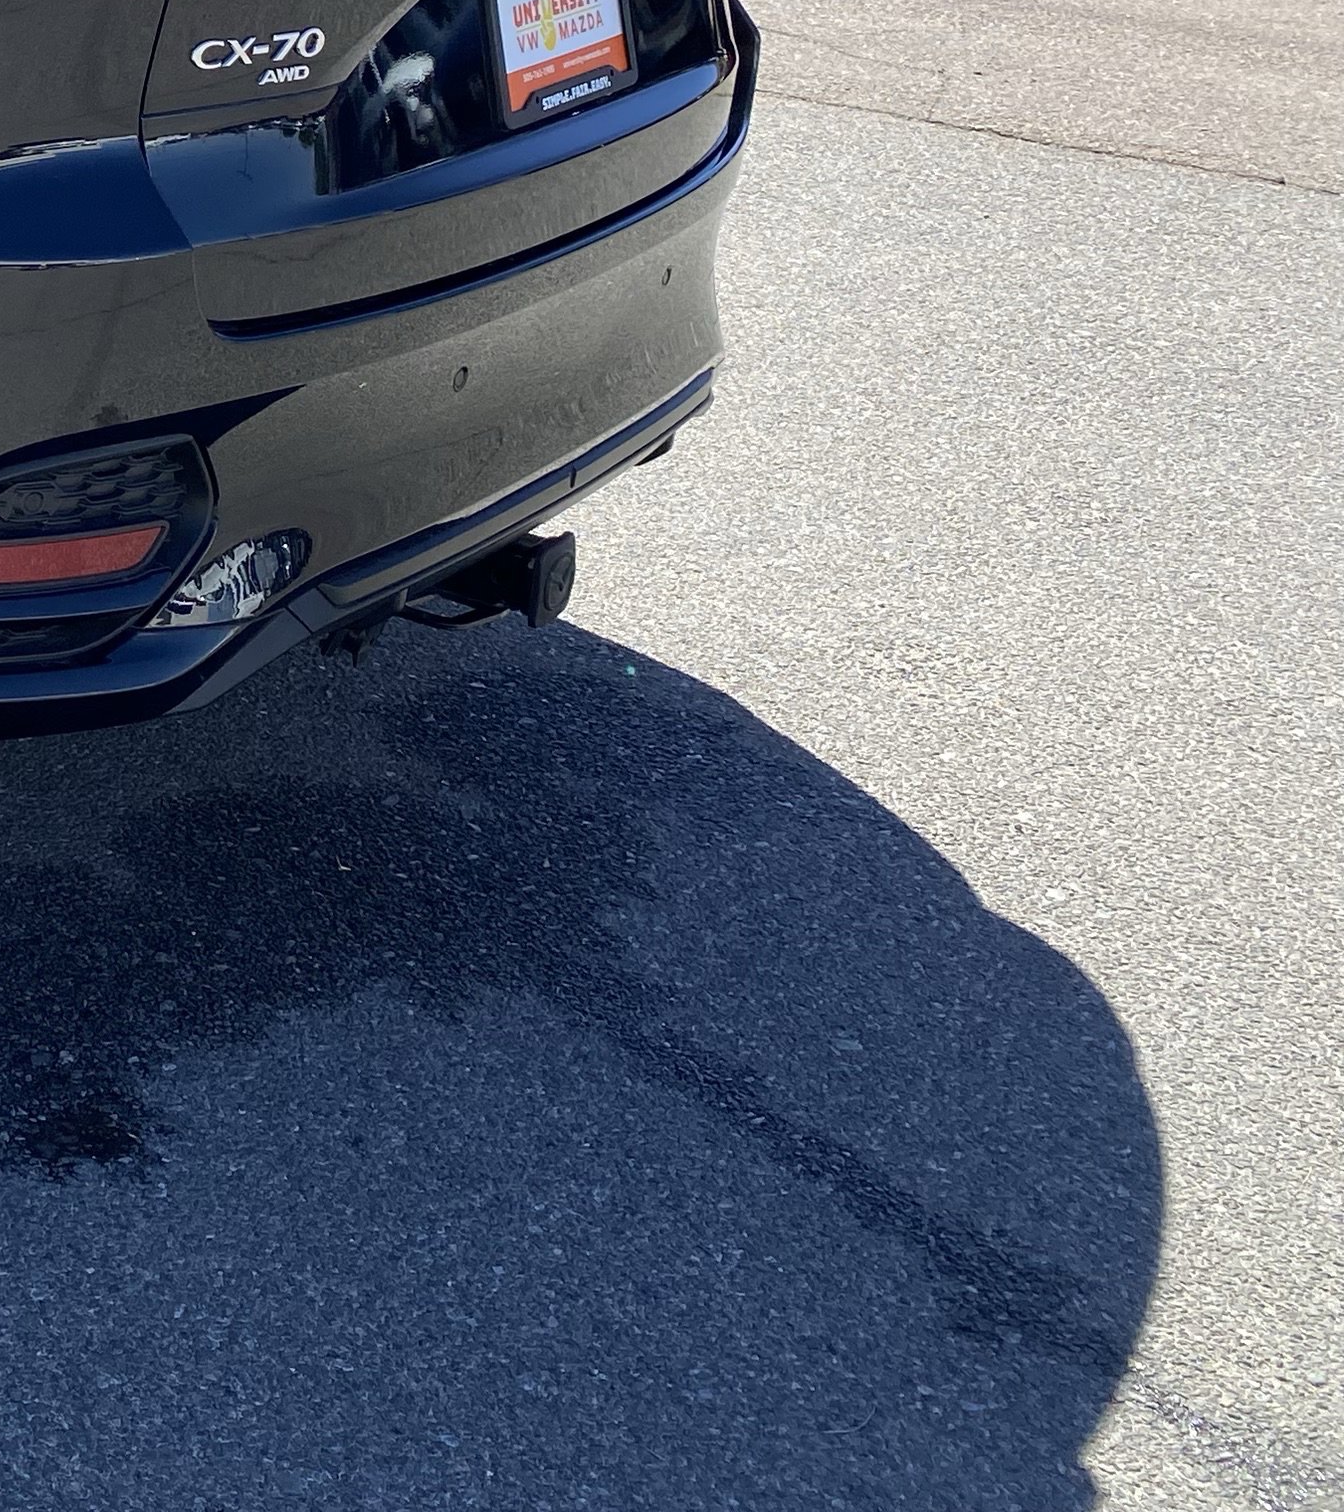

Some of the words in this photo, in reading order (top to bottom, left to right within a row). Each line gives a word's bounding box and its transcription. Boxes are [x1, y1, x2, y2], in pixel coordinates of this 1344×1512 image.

[191, 27, 326, 70] CX-70
[516, 30, 540, 53] VW
[558, 10, 604, 40] MAZDA
[258, 65, 310, 85] AWD
